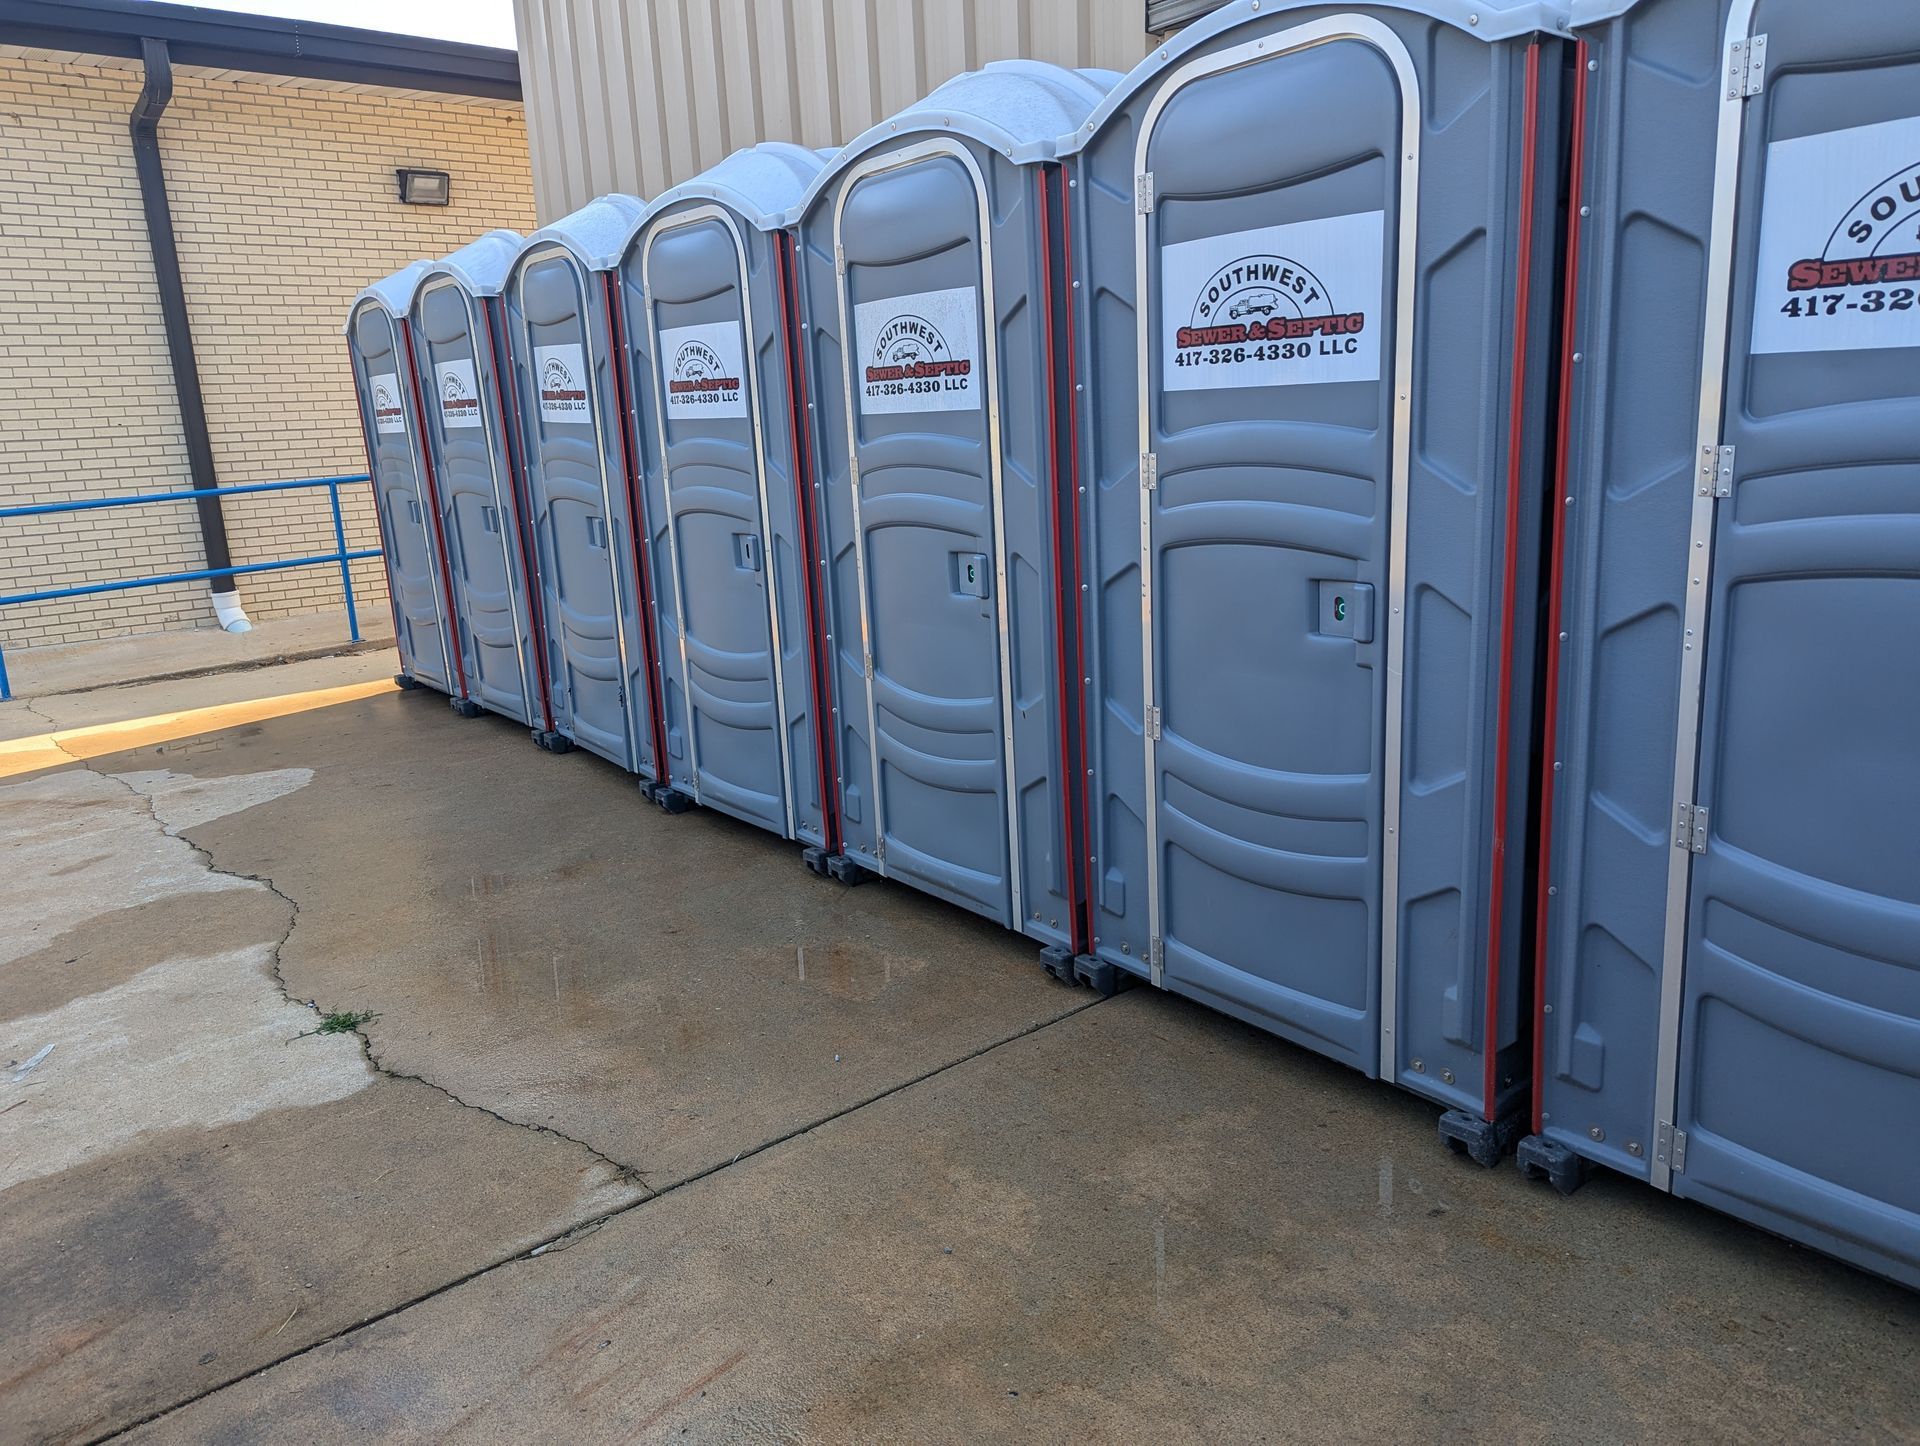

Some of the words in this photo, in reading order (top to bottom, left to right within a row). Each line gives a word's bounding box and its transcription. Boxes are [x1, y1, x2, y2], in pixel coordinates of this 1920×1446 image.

[1787, 253, 1920, 292] SEWE
[1199, 263, 1320, 318] SOUTHWEST
[1780, 288, 1920, 318] 417-32
[876, 321, 943, 360] SOUTHWEST
[1176, 323, 1248, 349] SEWER
[1266, 312, 1364, 339] SEPTIC
[675, 345, 720, 375] SOUTHWEST
[1175, 342, 1311, 367] 417-326-4330
[1319, 338, 1358, 356] LLC
[701, 377, 740, 391] SEPTIC
[866, 365, 904, 383] SEWER
[914, 359, 971, 379] SEPTIC
[670, 393, 720, 405] 417-326-4330
[722, 392, 739, 402] LLC
[865, 380, 941, 397] 417-326-4330
[944, 378, 968, 391] LLC
[574, 402, 586, 411] LLC
